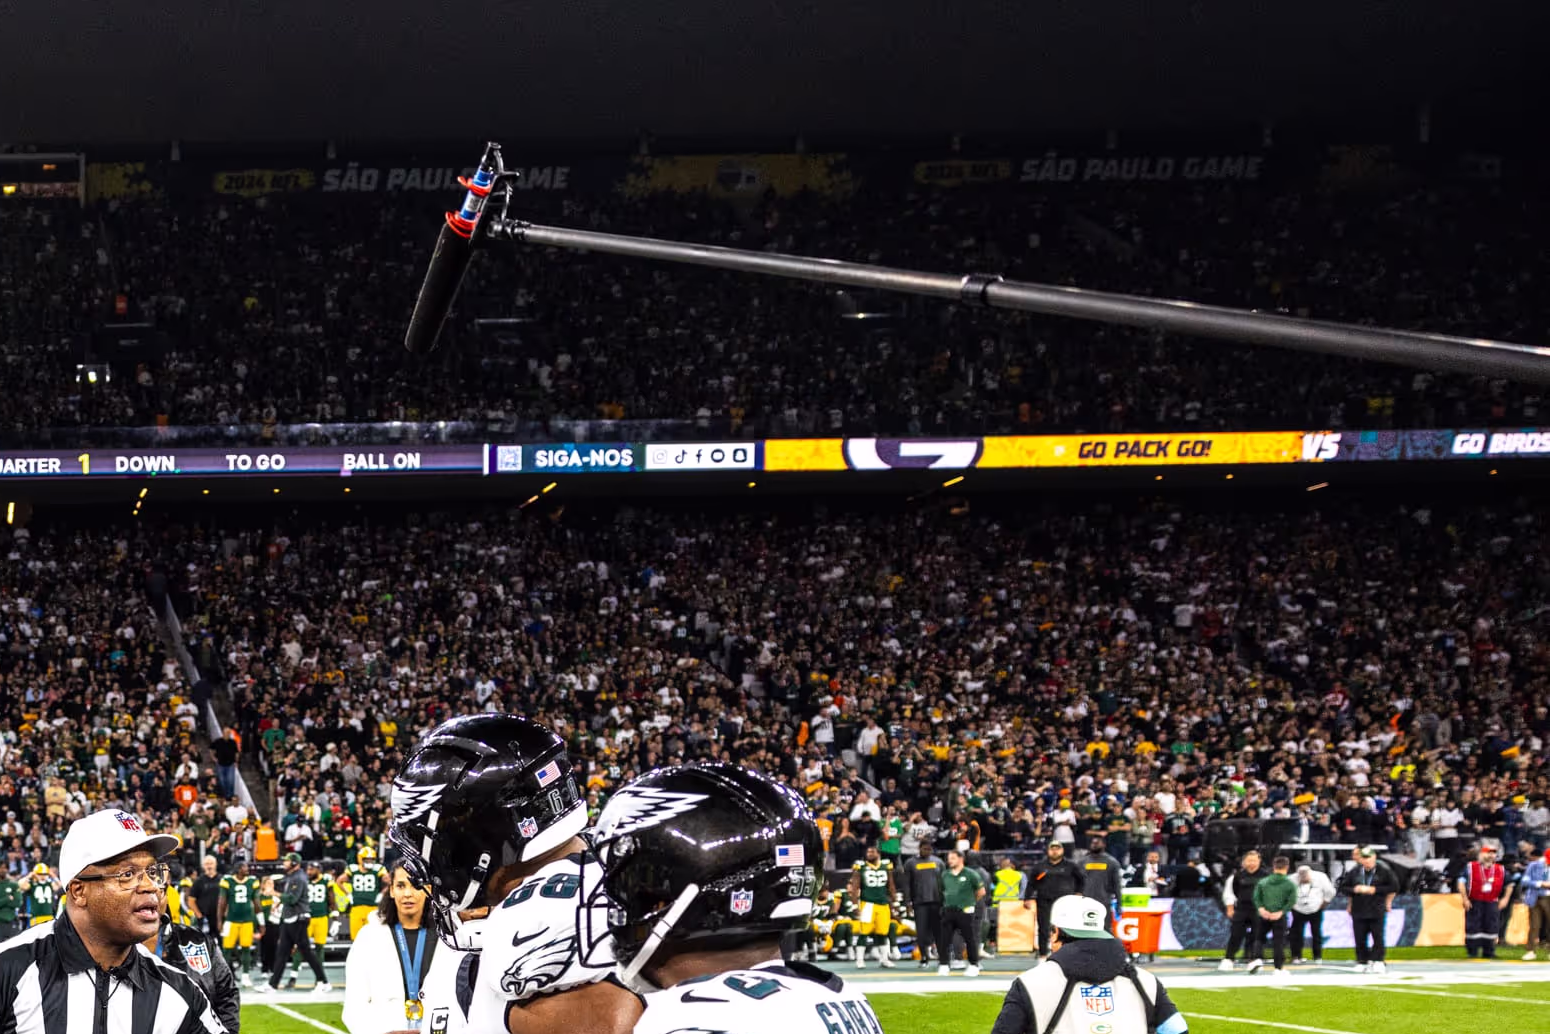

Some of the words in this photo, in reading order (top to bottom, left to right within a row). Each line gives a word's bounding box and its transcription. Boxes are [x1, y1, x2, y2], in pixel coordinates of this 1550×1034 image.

[1020, 150, 1077, 181] SÃO
[1082, 157, 1174, 181] PAULO
[1181, 156, 1265, 180] GAME
[322, 162, 380, 192] SÃO
[1078, 441, 1106, 459] GO
[1114, 440, 1171, 459] PACK
[1176, 440, 1213, 457] GO!
[1302, 433, 1341, 460] VS
[1452, 433, 1486, 454] GO
[78, 453, 91, 475] 1
[115, 456, 176, 472] DOWN
[226, 455, 251, 470] TO
[256, 455, 286, 470] GO
[343, 454, 390, 470] BALL
[394, 453, 421, 470] ON
[535, 448, 634, 467] SIGA-NOS
[353, 874, 376, 892] 88
[788, 866, 816, 897] 55
[864, 871, 889, 888] 62
[34, 885, 52, 904] 44
[234, 885, 248, 903] 2
[1116, 917, 1139, 941] G
[1085, 998, 1112, 1013] NFL
